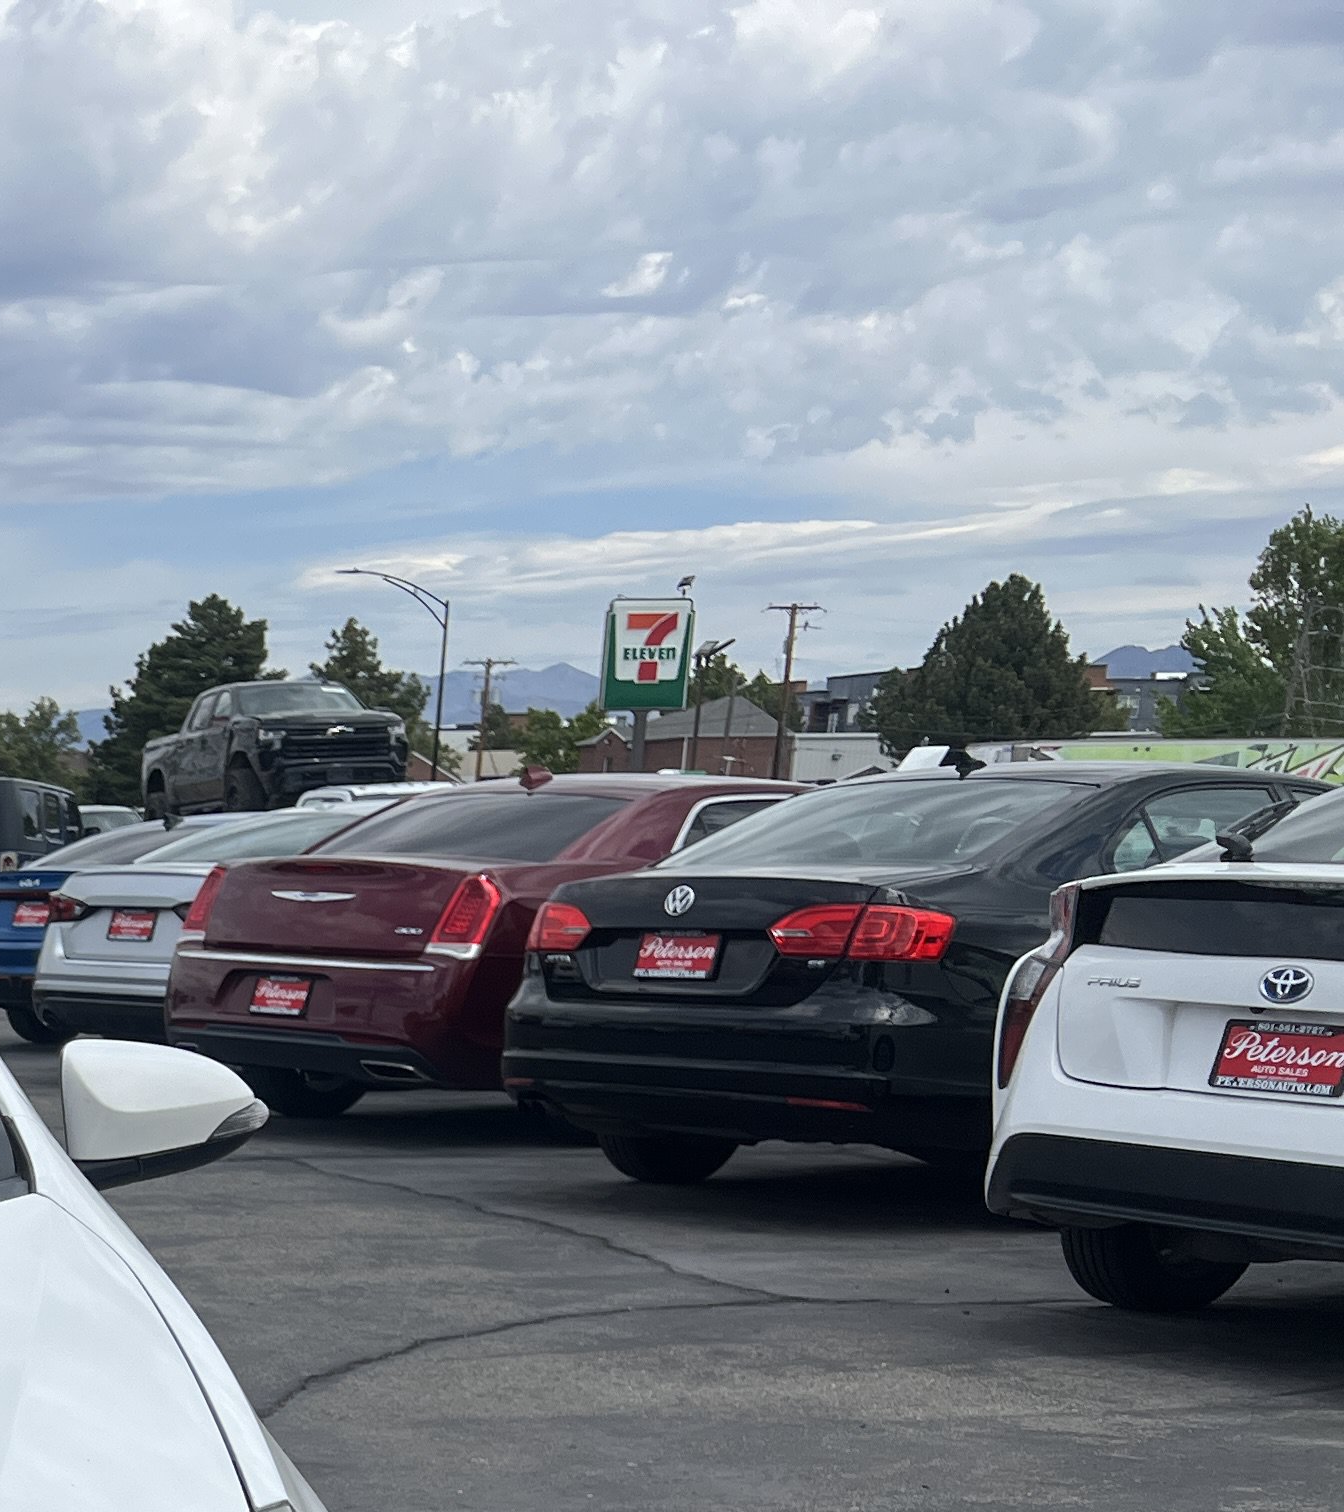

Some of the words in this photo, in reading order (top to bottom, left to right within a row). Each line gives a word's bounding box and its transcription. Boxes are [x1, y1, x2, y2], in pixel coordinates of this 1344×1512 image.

[627, 612, 679, 681] 7
[639, 936, 715, 960] Peterson
[1086, 975, 1142, 988] PRIUS
[1223, 1031, 1344, 1068] Peterson
[1250, 1065, 1276, 1075] AUTO
[1278, 1067, 1309, 1077] SALES
